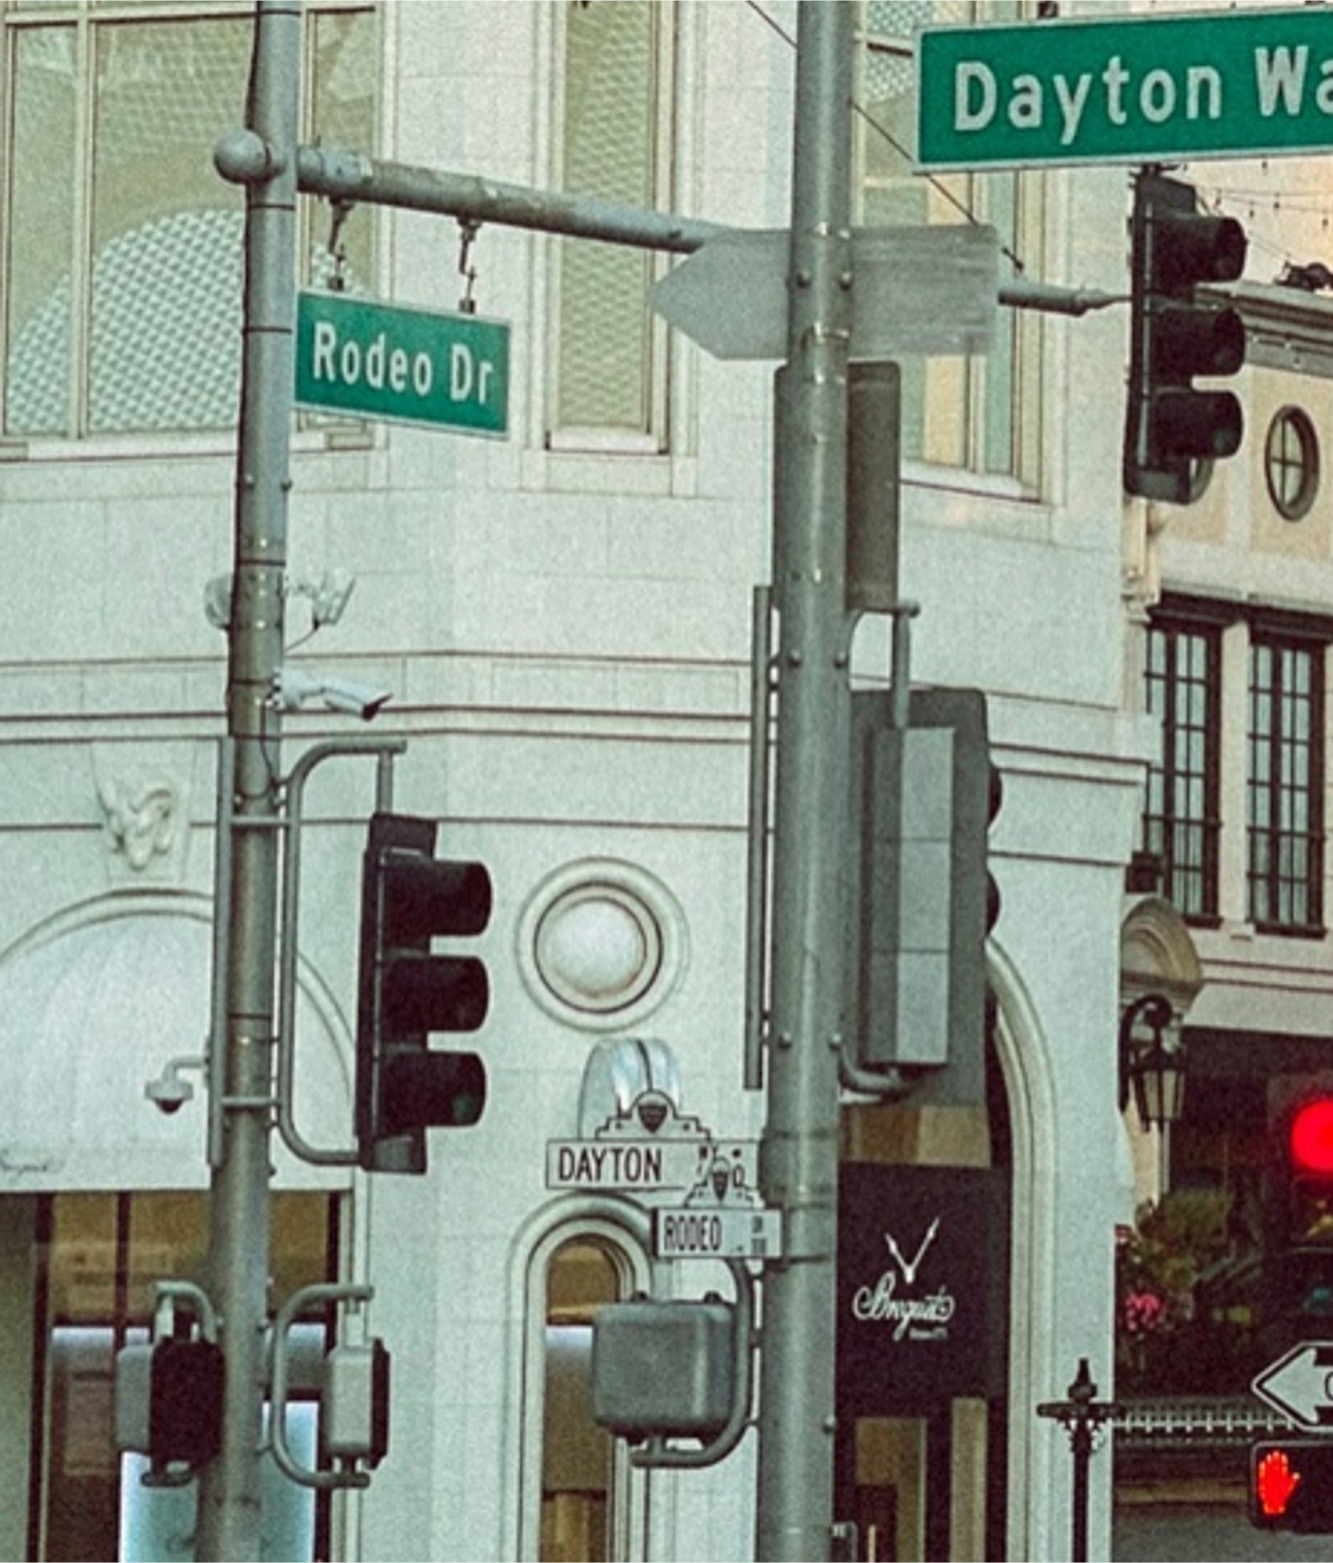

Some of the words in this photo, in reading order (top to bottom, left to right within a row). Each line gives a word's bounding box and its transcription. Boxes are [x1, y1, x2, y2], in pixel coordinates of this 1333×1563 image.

[954, 56, 1223, 145] Dayton
[313, 321, 432, 396] Rodeo
[450, 343, 494, 405] Dr
[558, 1147, 662, 1182] DAYTON
[663, 1215, 722, 1251] RODEO
